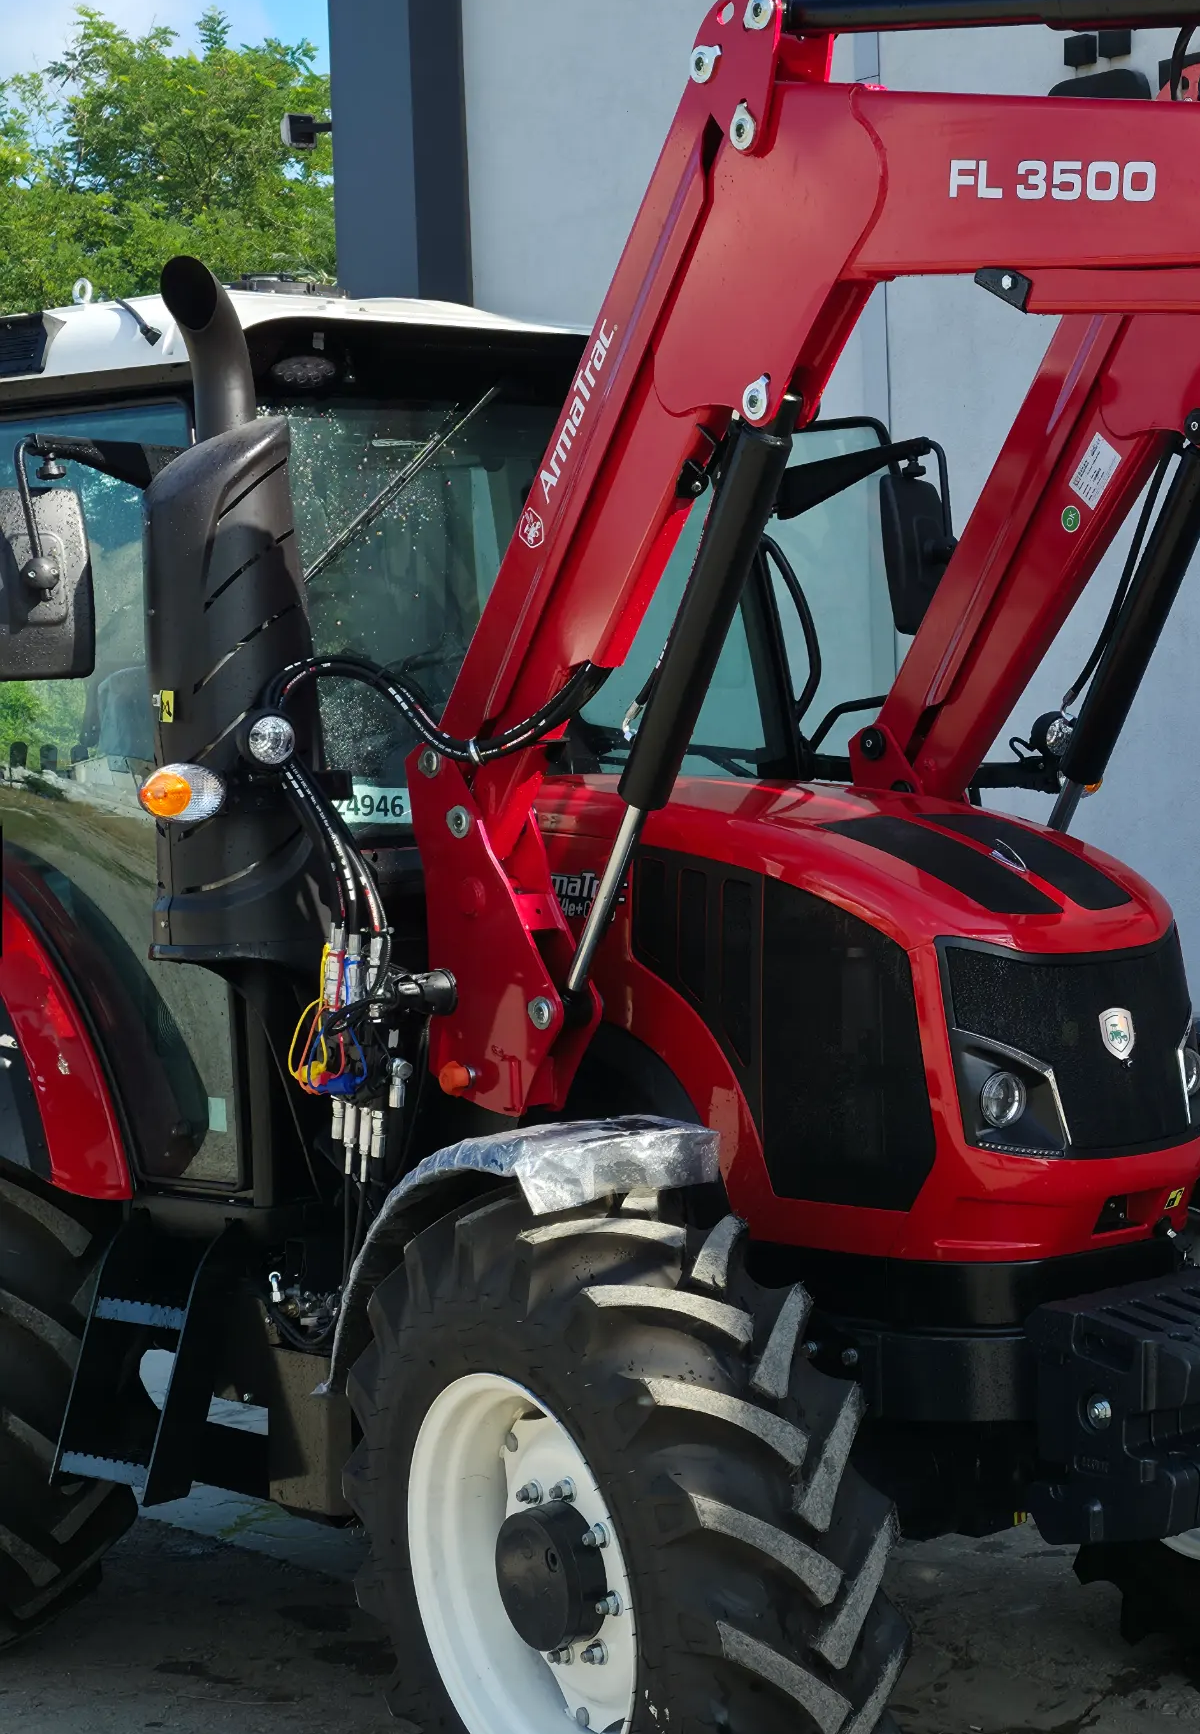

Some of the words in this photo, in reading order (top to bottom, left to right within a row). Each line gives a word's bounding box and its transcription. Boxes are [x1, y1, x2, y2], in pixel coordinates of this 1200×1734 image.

[949, 159, 1003, 198] FL
[1016, 160, 1156, 202] 3500
[540, 319, 614, 504] ArmaTrac
[1066, 510, 1076, 527] OK
